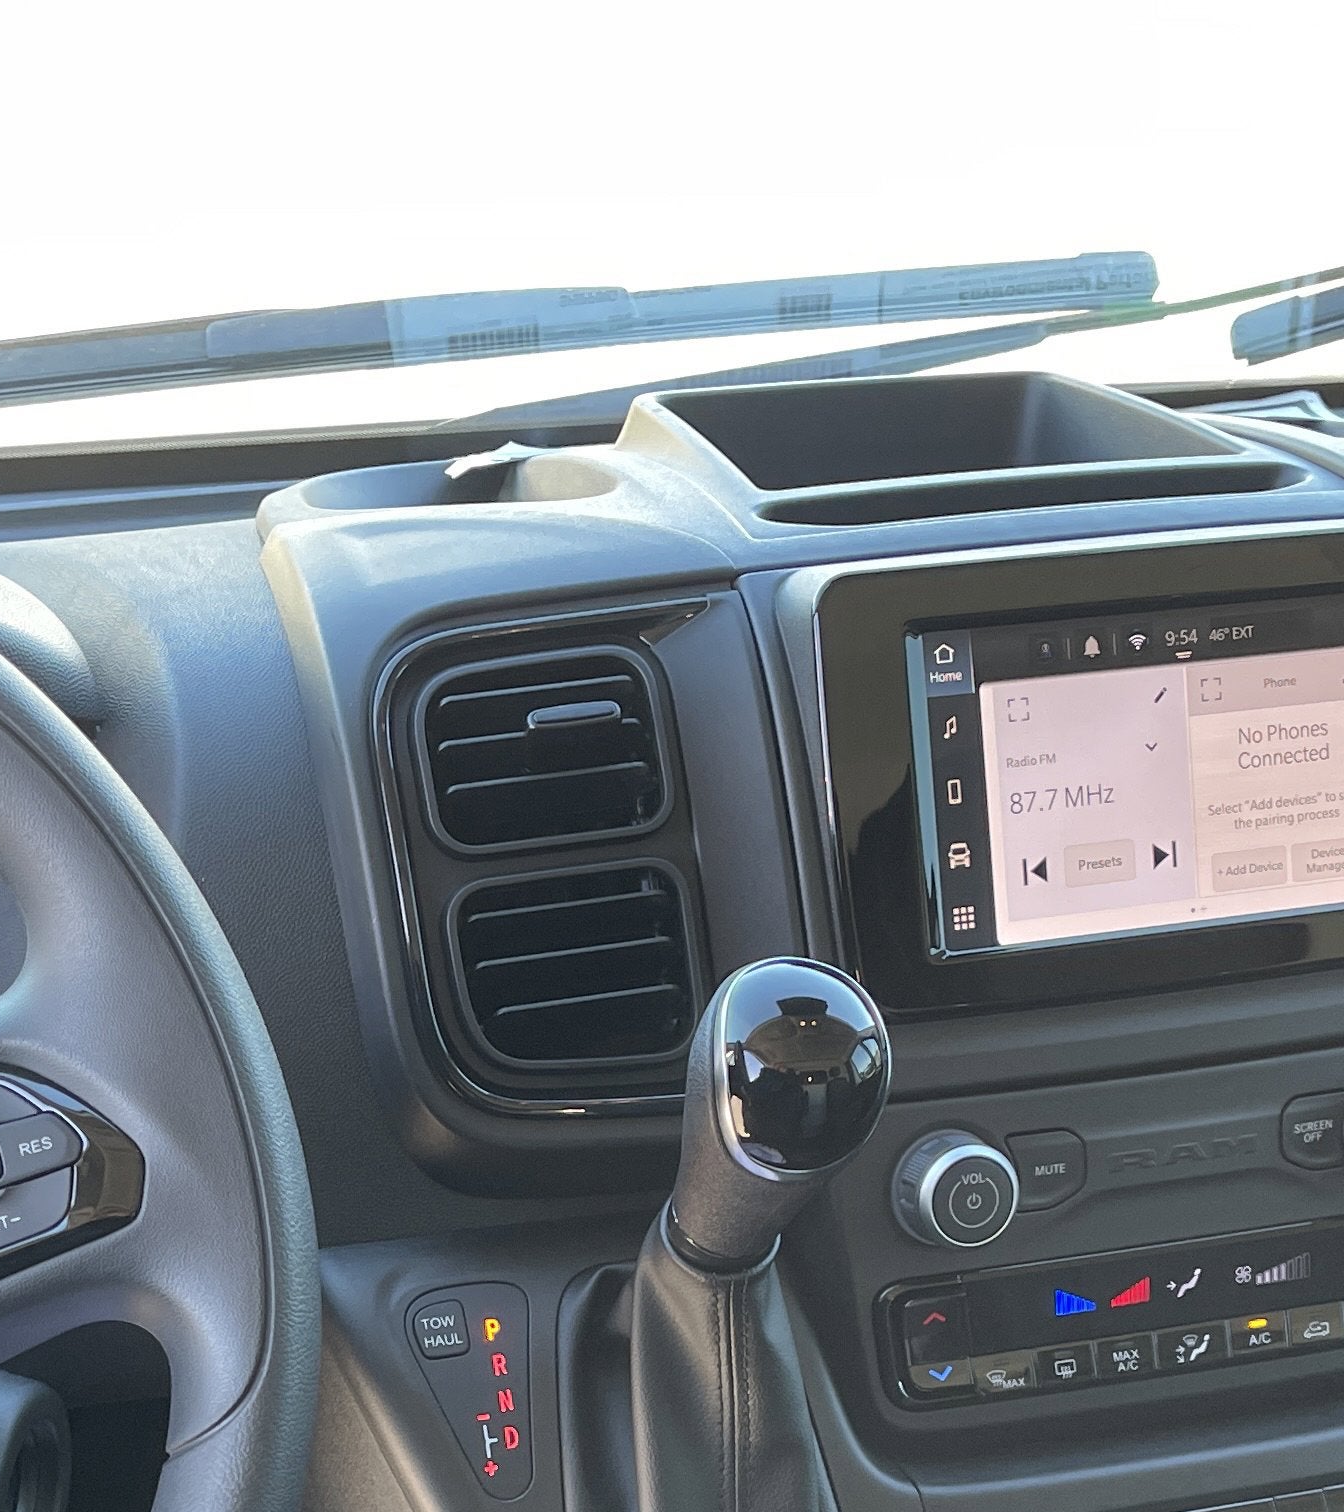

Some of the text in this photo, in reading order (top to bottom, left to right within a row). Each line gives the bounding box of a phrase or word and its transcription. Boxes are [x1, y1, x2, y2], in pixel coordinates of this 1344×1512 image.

[1165, 628, 1199, 647] 9:54
[1232, 625, 1255, 641] EXT
[929, 670, 963, 684] Home
[1263, 676, 1297, 689] Phone
[1237, 721, 1329, 745] No Phones
[1006, 752, 1057, 769] Radio FM
[1237, 742, 1331, 770] Connected
[1009, 783, 1116, 815] 87.7 MHz
[1207, 802, 1243, 817] Select
[1324, 792, 1337, 803] to
[1233, 807, 1341, 831] the pairing process
[1078, 856, 1123, 871] Presets
[1225, 863, 1247, 877] Add
[1248, 861, 1284, 875] Device
[1293, 1119, 1334, 1135] SCREEN
[1303, 1131, 1323, 1144] OFF
[18, 1135, 54, 1157] RES
[1034, 1162, 1066, 1177] MUTE
[960, 1172, 987, 1185] VOL
[420, 1315, 455, 1331] TOW
[483, 1317, 501, 1342] P
[423, 1332, 464, 1349] HAUL
[1248, 1331, 1272, 1347] A/C
[1112, 1348, 1140, 1363] MAX
[491, 1352, 508, 1377] R
[1117, 1360, 1139, 1373] A/C
[1002, 1377, 1026, 1390] MAX
[497, 1388, 515, 1413] N
[503, 1425, 519, 1450] D
